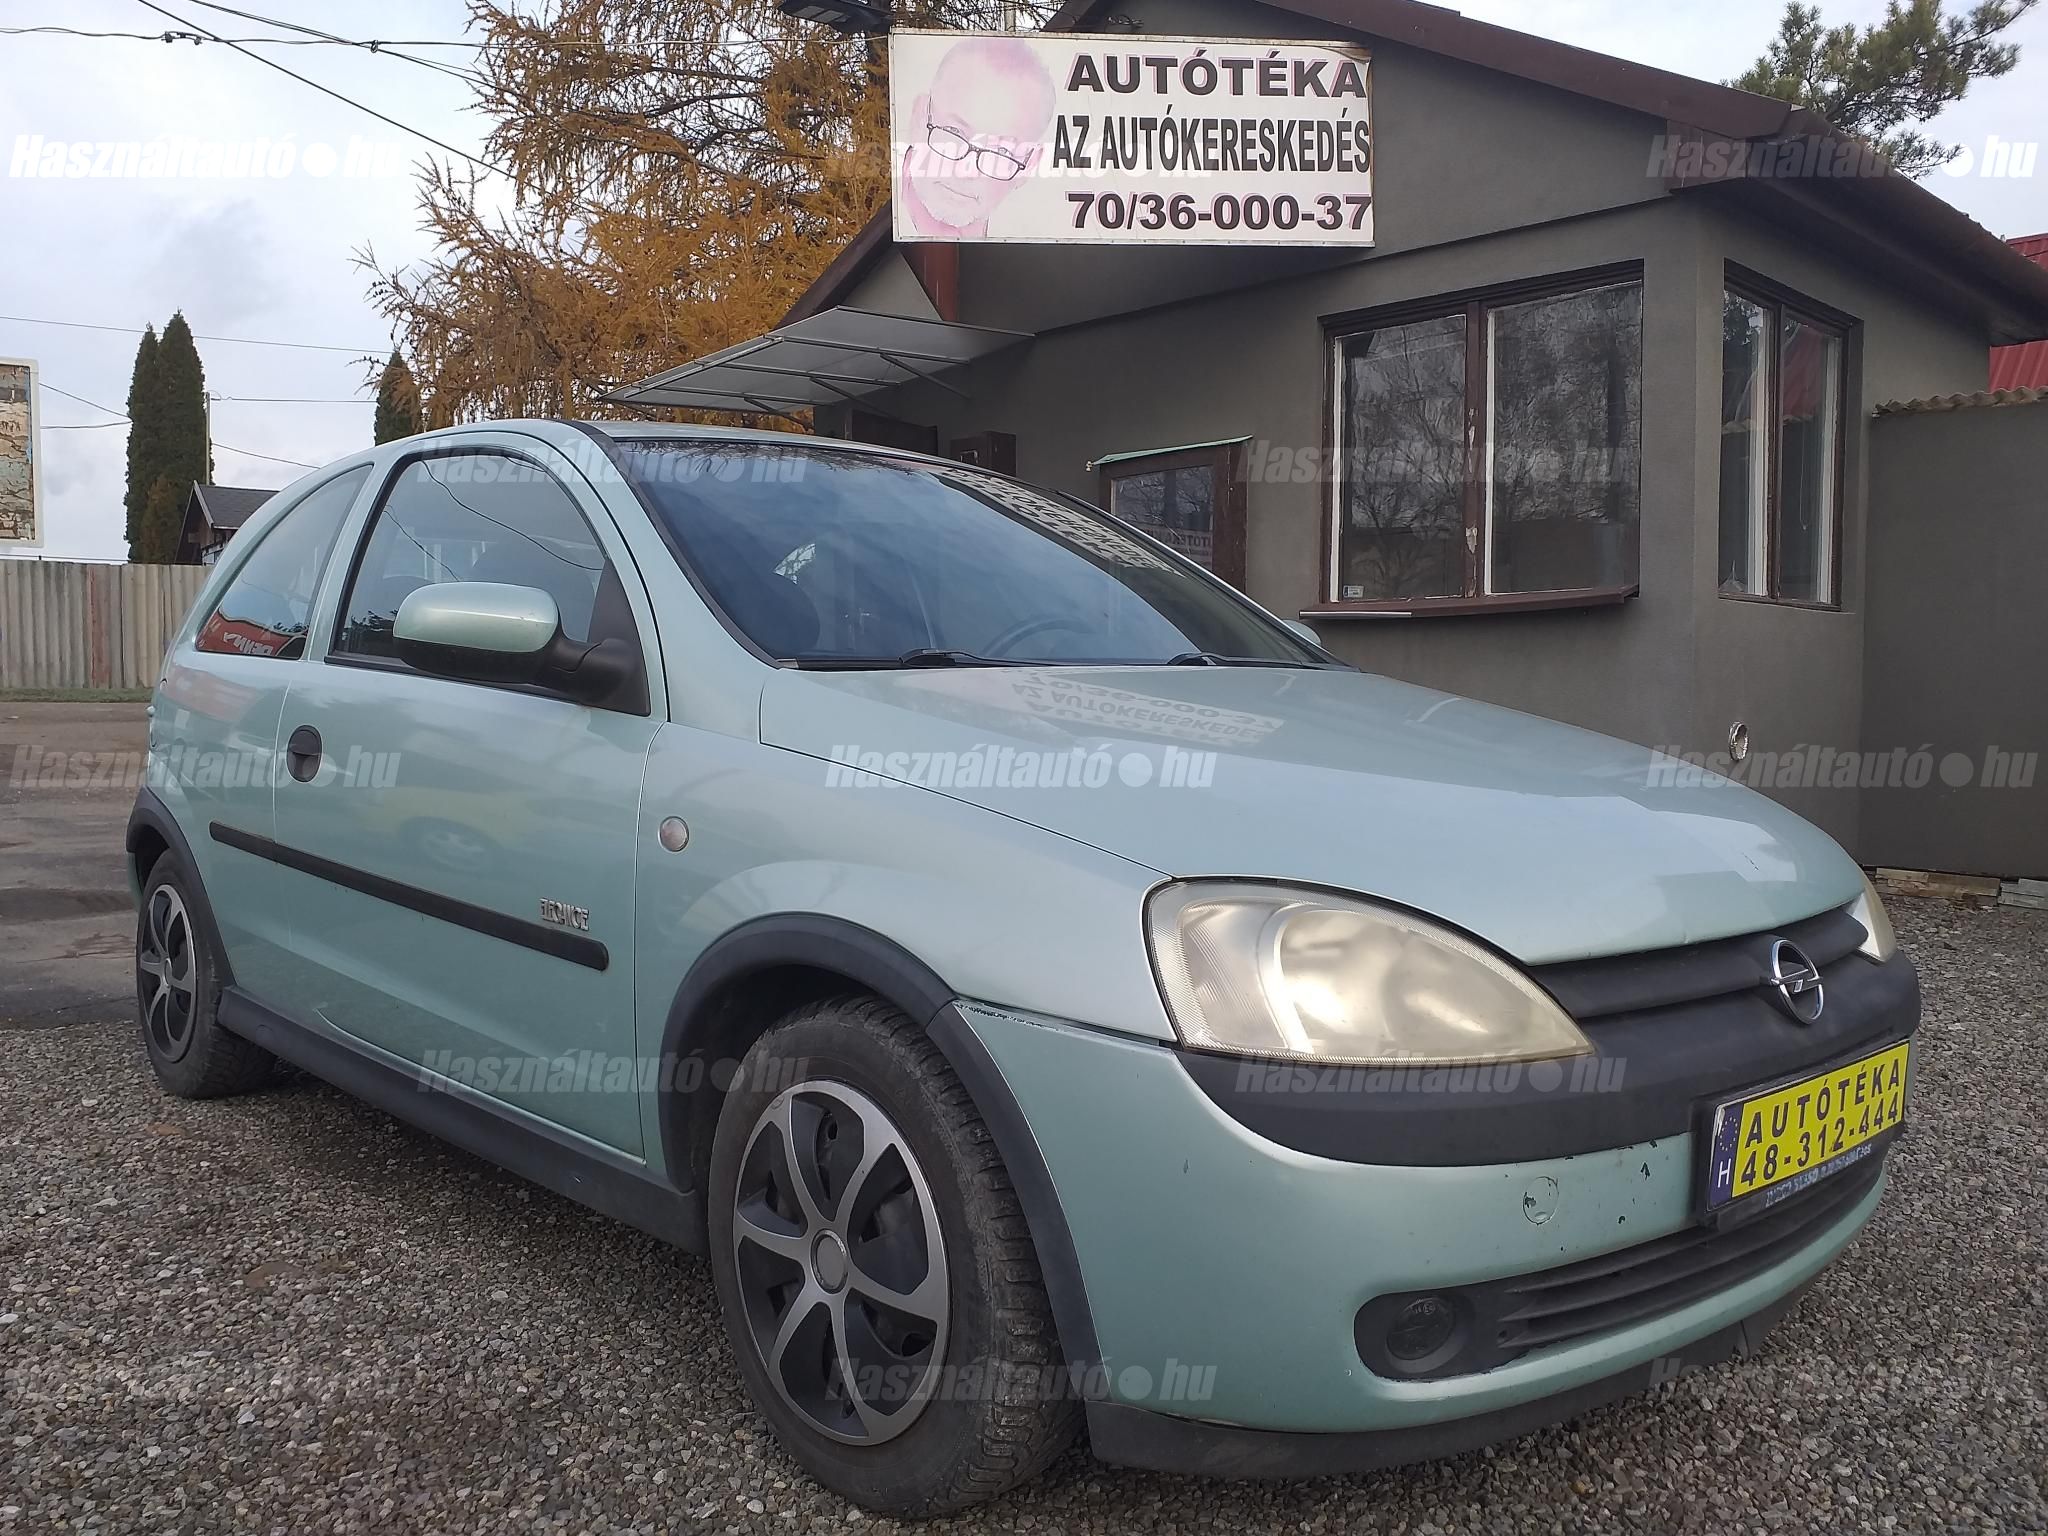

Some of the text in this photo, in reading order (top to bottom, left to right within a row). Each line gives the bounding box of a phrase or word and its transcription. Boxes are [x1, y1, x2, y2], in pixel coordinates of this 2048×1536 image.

[1067, 48, 1367, 98] AUTÓTÉKA
[1053, 104, 1370, 174] AZ AUTÓKERESKEDÉS
[1067, 192, 1371, 231] 70/36-000-37
[1745, 1059, 1900, 1148] AUTÓTÉKA
[1741, 1091, 1899, 1186] 48-312-444
[1717, 1158, 1731, 1187] H
